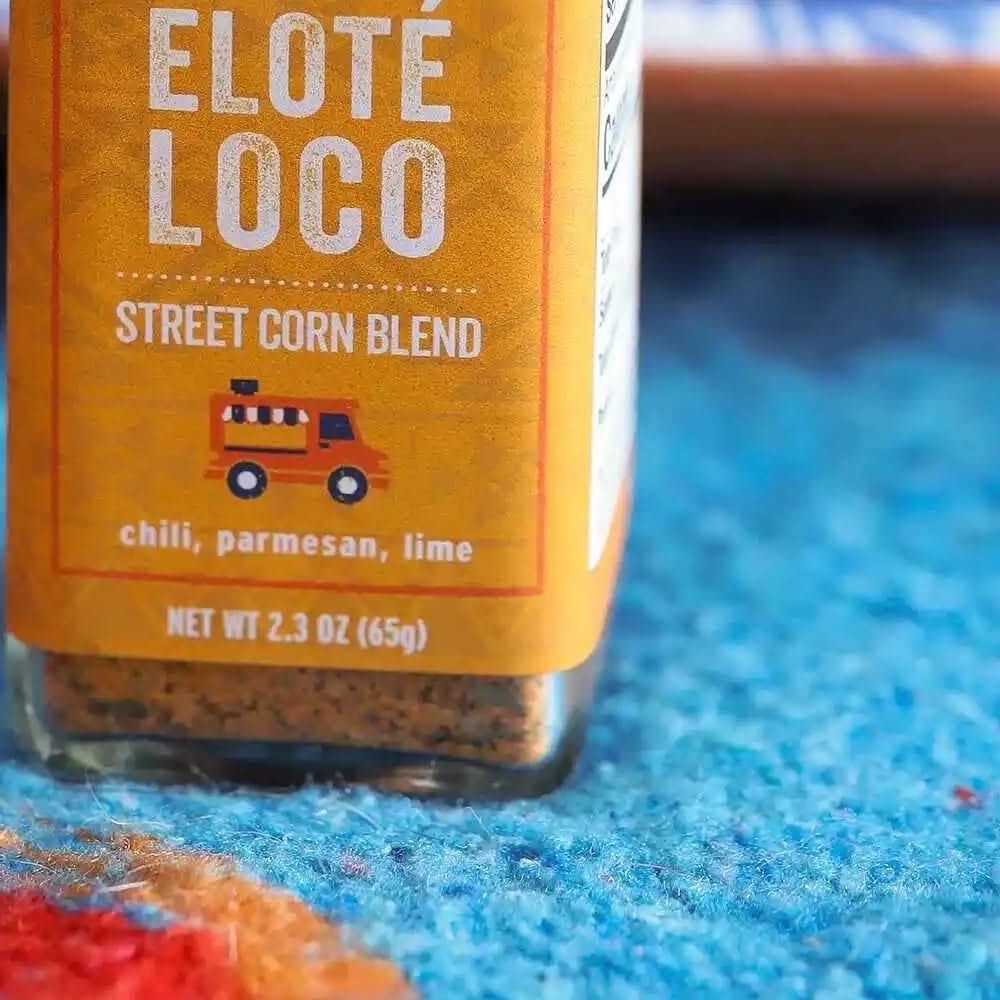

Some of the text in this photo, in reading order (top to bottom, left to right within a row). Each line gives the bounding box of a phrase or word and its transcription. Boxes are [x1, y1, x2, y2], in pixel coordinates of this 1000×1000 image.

[149, 128, 446, 258] LOCO
[115, 300, 482, 359] STREET CORN BLEND
[119, 520, 473, 564] chili, parmesan, lime
[167, 606, 428, 654] NET WT 2.3 OZ (65g)
